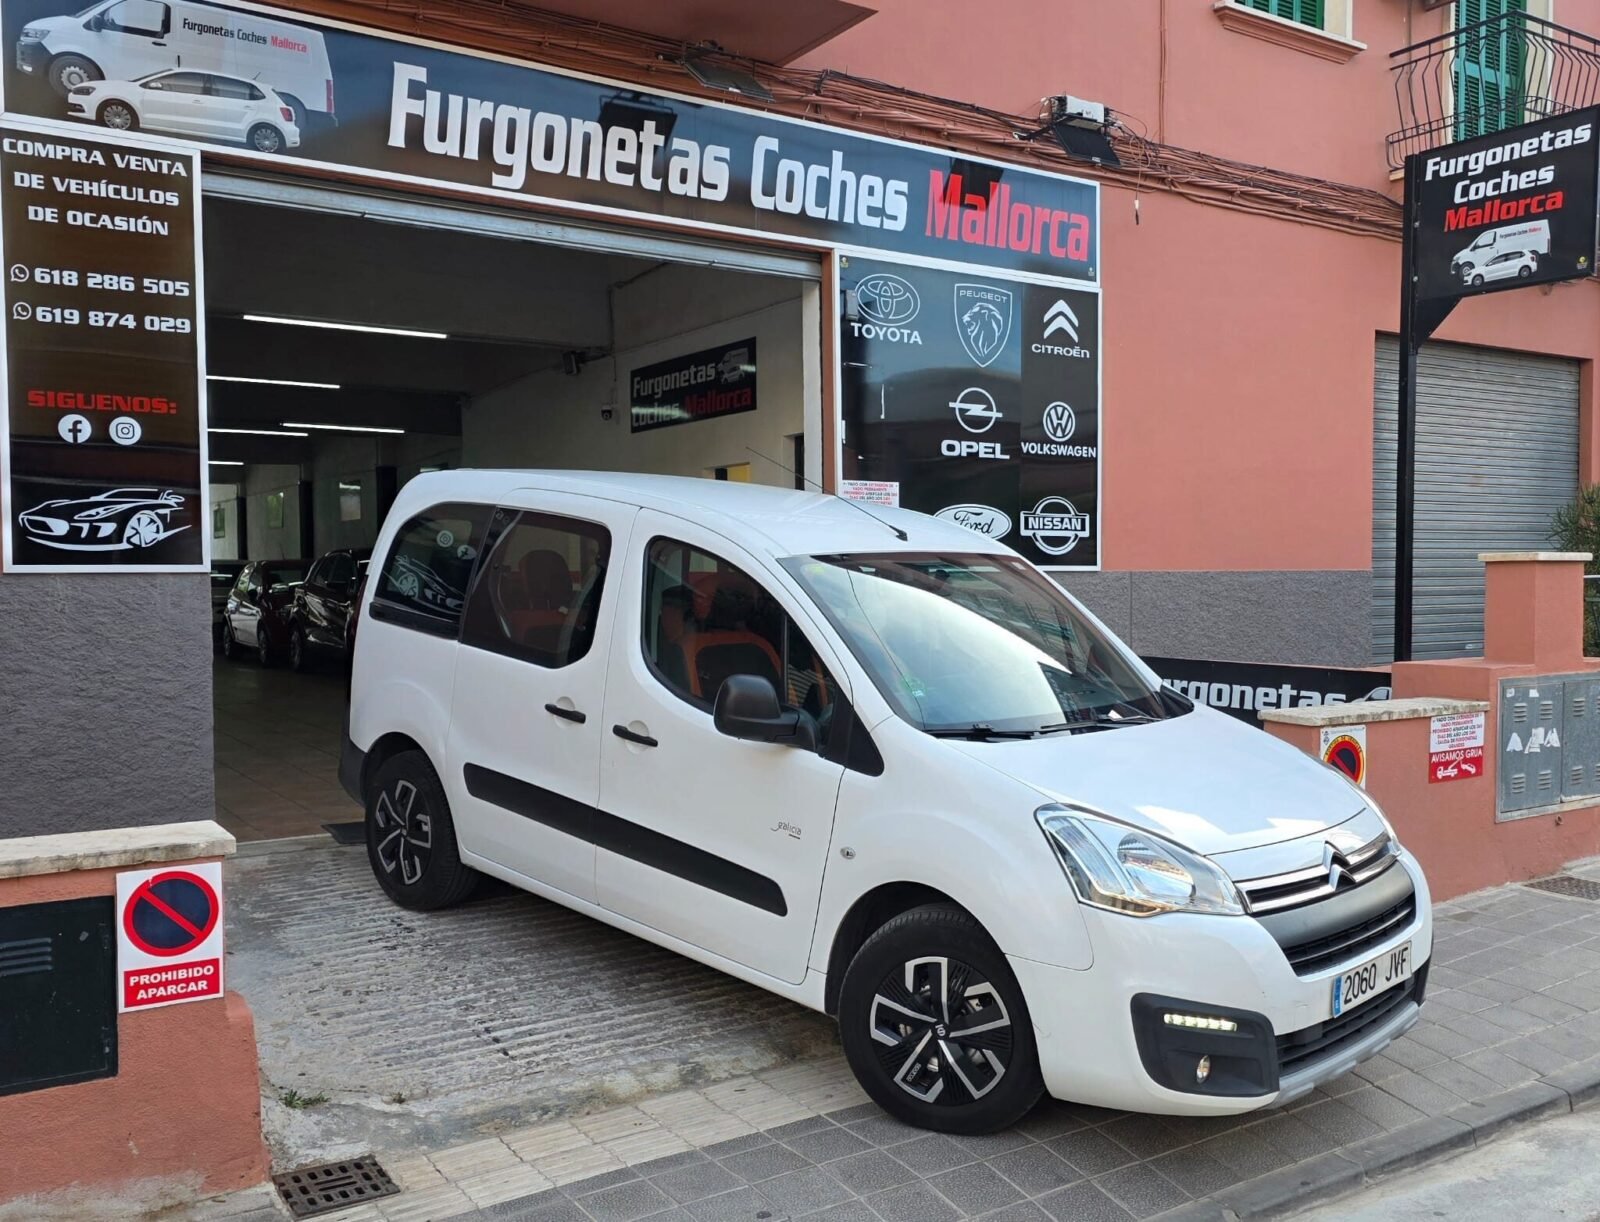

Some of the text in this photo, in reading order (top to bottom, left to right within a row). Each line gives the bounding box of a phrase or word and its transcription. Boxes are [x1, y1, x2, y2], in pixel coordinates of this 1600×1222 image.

[183, 18, 307, 53] Furgonetas Coches Mallorca
[3, 137, 187, 177] COMPRA VENTA
[388, 61, 1089, 262] Furgonetas Coches Mallorca
[1425, 123, 1592, 182] Furgonetas
[14, 171, 179, 206] DE VEHÍCULOS
[1453, 165, 1555, 204] Coches
[28, 205, 168, 236] DE OCASIÓN
[1443, 191, 1564, 232] Mallorca
[34, 267, 190, 297] 618 286 505
[959, 289, 1008, 304] PEUGEOT
[36, 306, 191, 333] 619 874 029
[850, 322, 923, 345] TOYOTA
[633, 363, 716, 398] Furgonetas
[28, 390, 177, 414] SIGUENOS:
[684, 387, 752, 417] Mallorca
[941, 440, 1010, 460] OPEL
[1021, 442, 1097, 459] VOLKSWAGEN
[954, 510, 994, 534] Ford
[1028, 516, 1082, 531] NISSAN
[1431, 748, 1483, 763] AVISAMOS GRUA
[770, 821, 802, 836] galicia
[129, 965, 214, 987] PROHIBIDO
[136, 980, 208, 1000] APARCAR
[1344, 947, 1409, 1005] 2060 JVF
